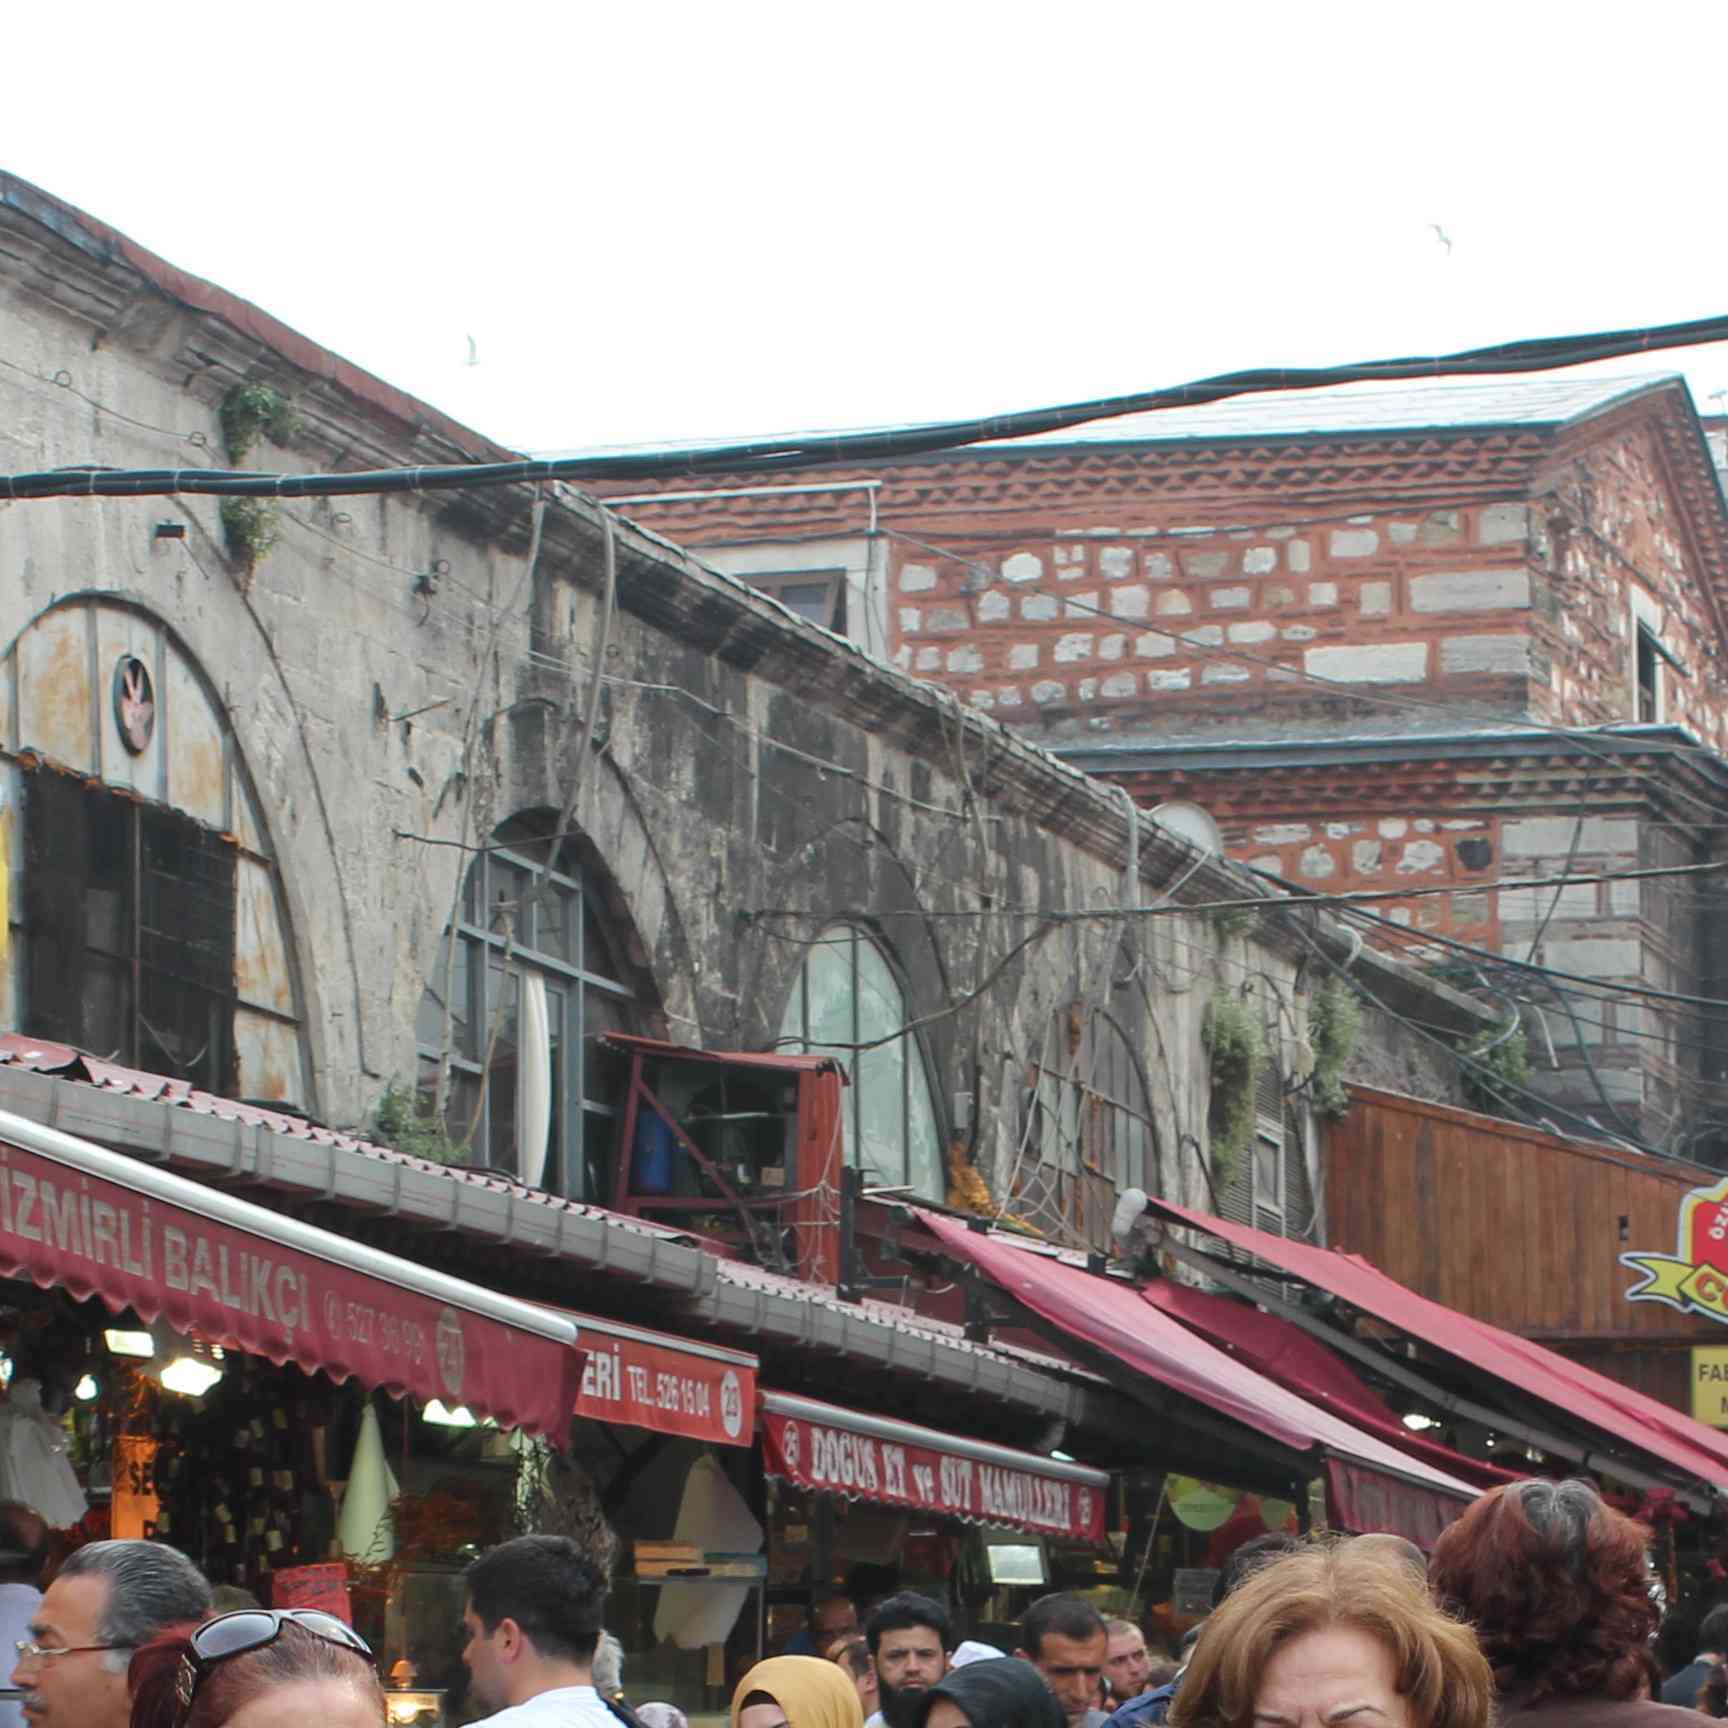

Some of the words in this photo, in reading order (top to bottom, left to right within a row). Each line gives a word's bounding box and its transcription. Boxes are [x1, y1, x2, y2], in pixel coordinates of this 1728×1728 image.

[0, 1146, 153, 1282] İZMİRLİ
[163, 1227, 310, 1345] BALIKÇI
[882, 1443, 907, 1497] ET
